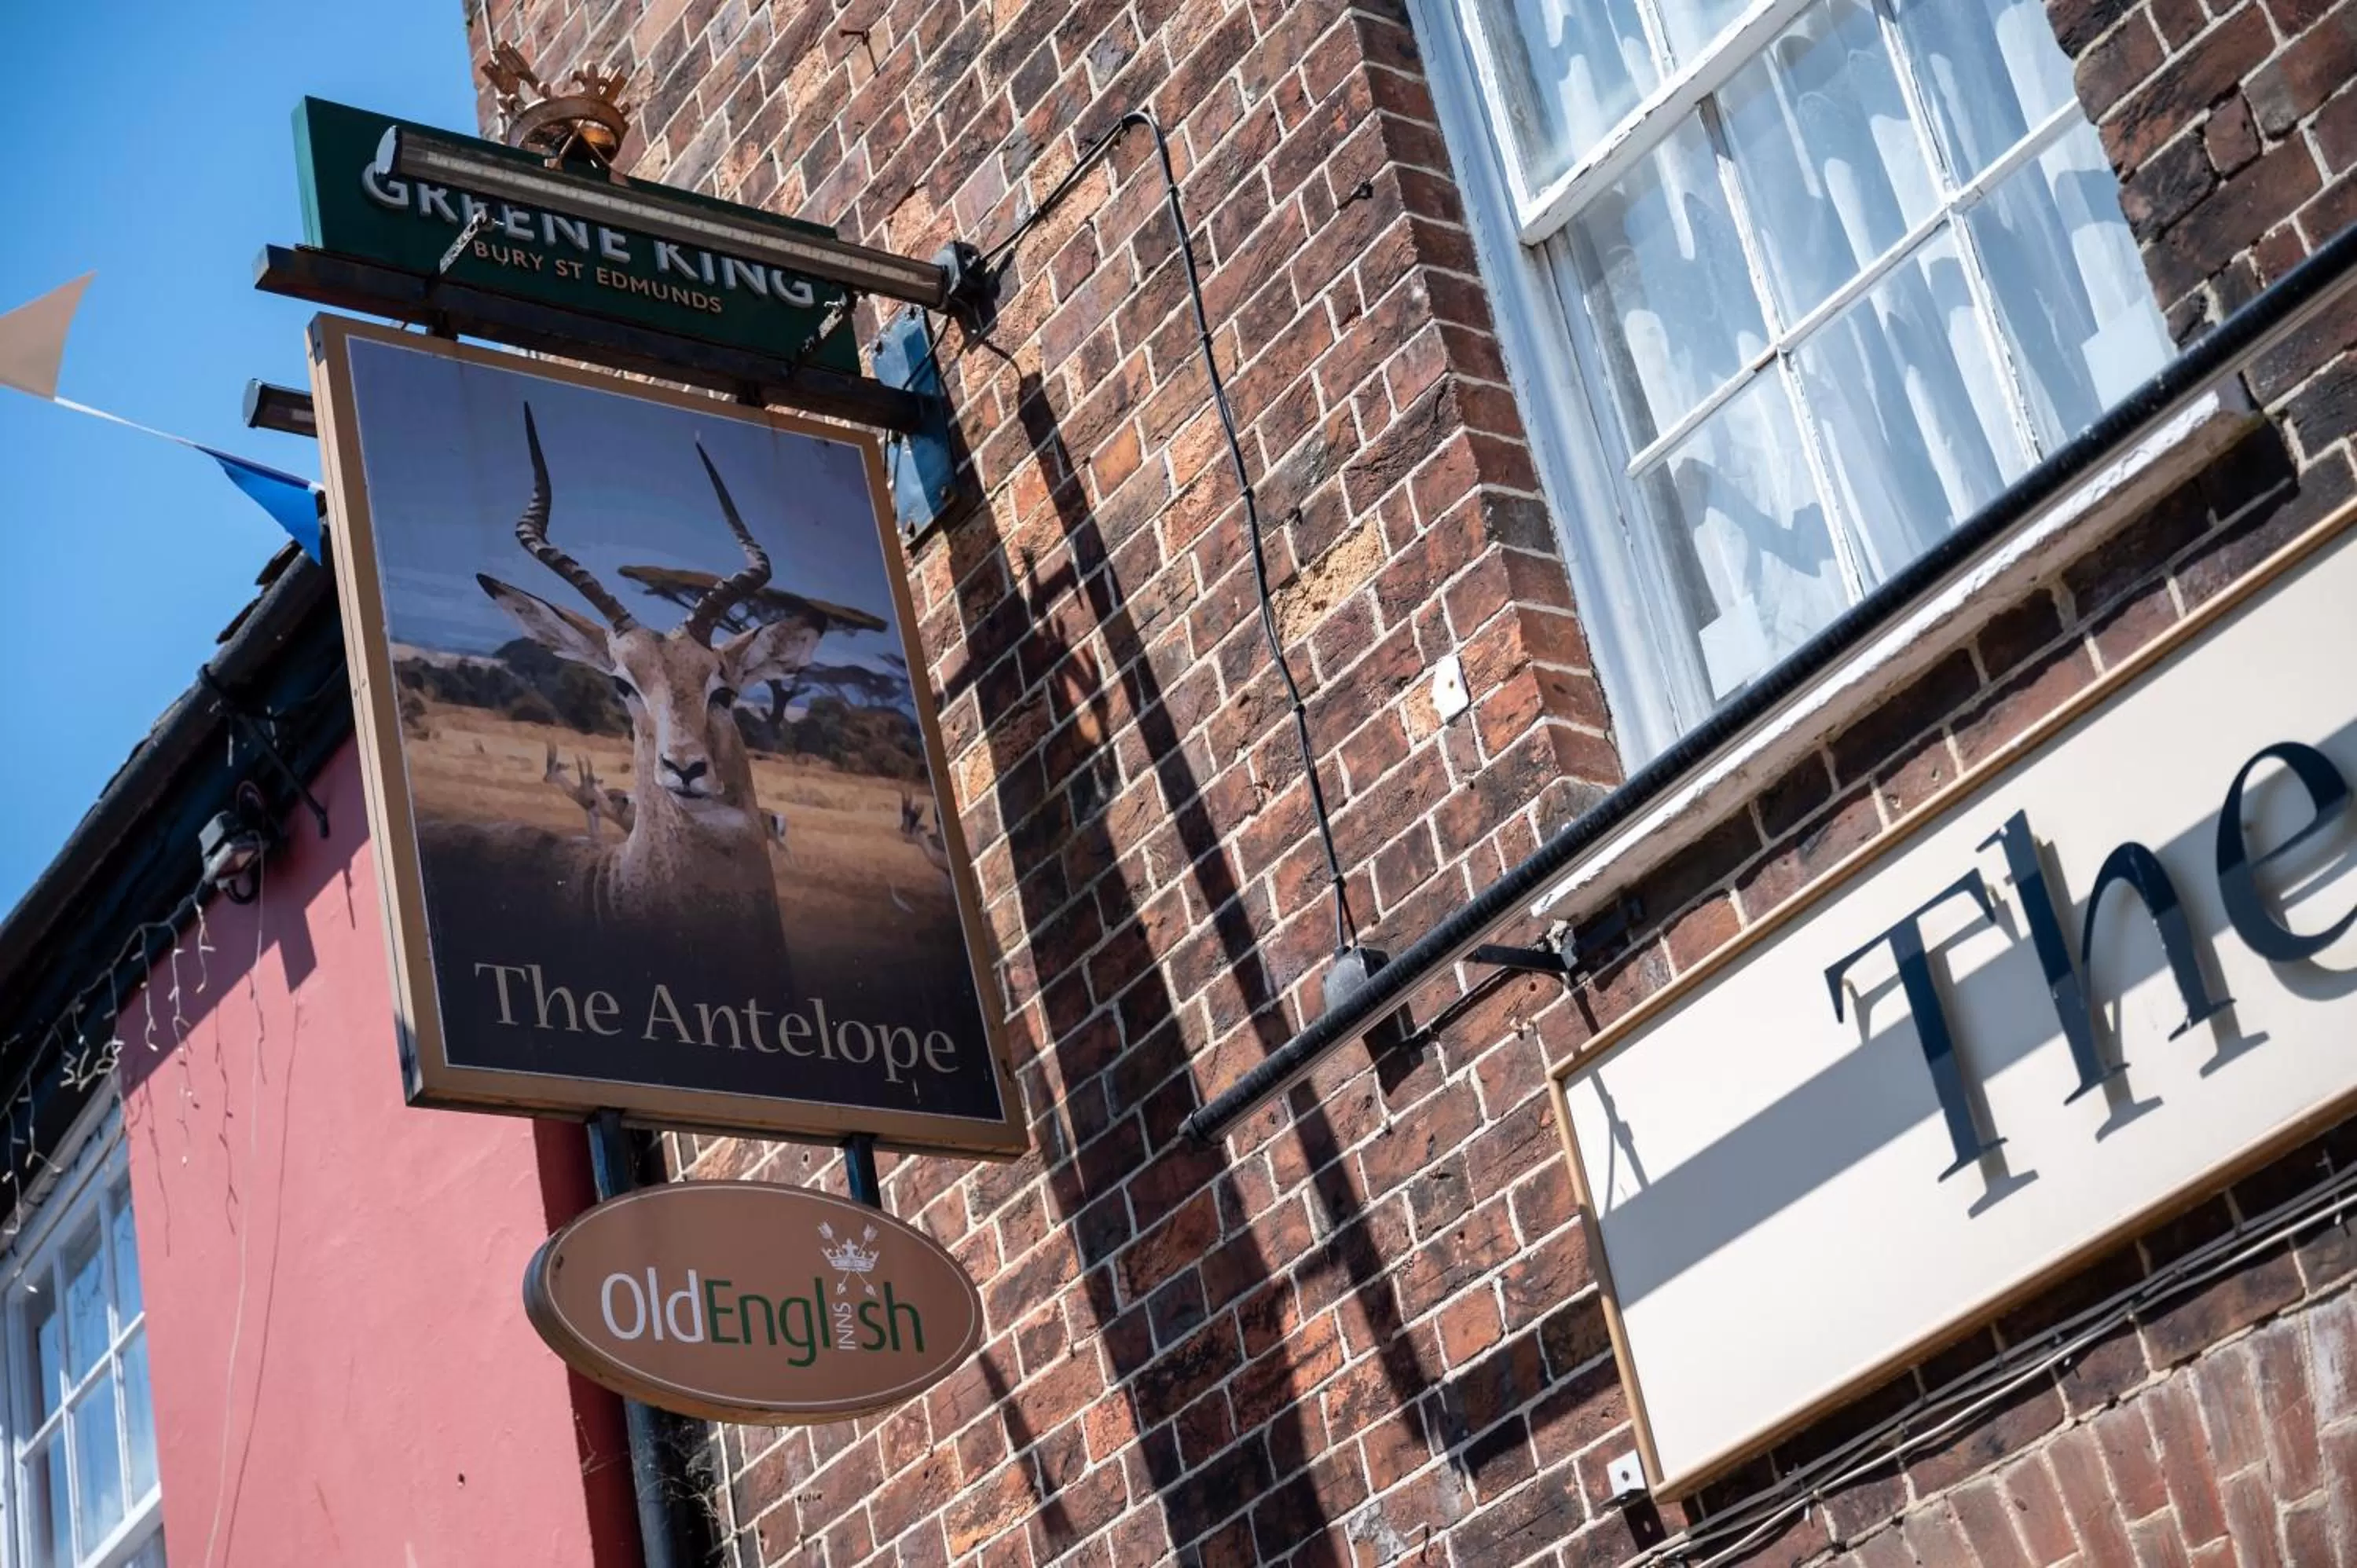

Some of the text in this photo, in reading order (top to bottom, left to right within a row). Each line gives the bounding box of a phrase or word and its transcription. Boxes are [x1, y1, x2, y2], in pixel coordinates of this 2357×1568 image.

[474, 239, 723, 314] BURY ST EDMUNDS
[653, 238, 815, 309] KING
[1824, 741, 2357, 1183] The
[474, 962, 959, 1083] The Antelope
[832, 1302, 857, 1350] INNS
